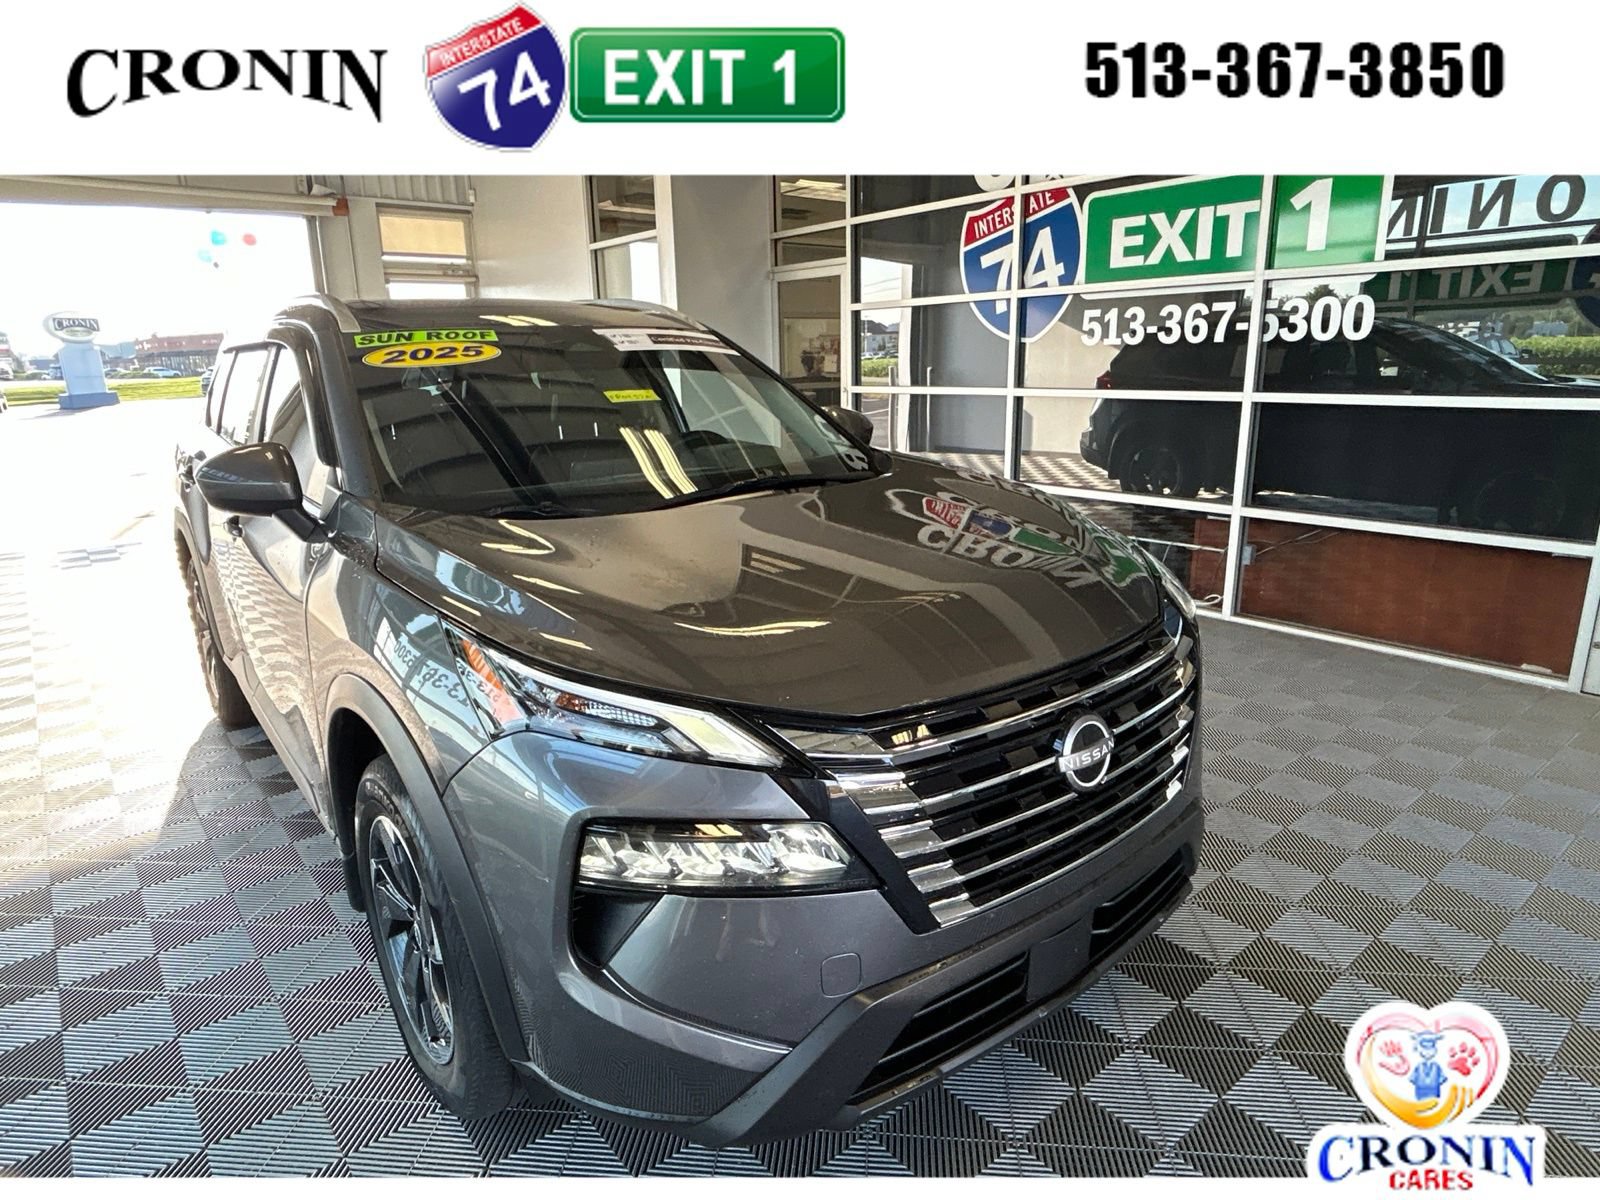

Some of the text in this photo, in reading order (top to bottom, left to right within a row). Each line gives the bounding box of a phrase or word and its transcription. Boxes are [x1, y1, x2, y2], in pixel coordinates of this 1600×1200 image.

[1110, 178, 1334, 269] EXIT 1
[980, 226, 1066, 315] 74
[54, 318, 99, 332] CRONIN
[358, 330, 492, 346] SUN ROOF
[381, 345, 485, 365] 2025
[1061, 735, 1115, 770] NISSAN
